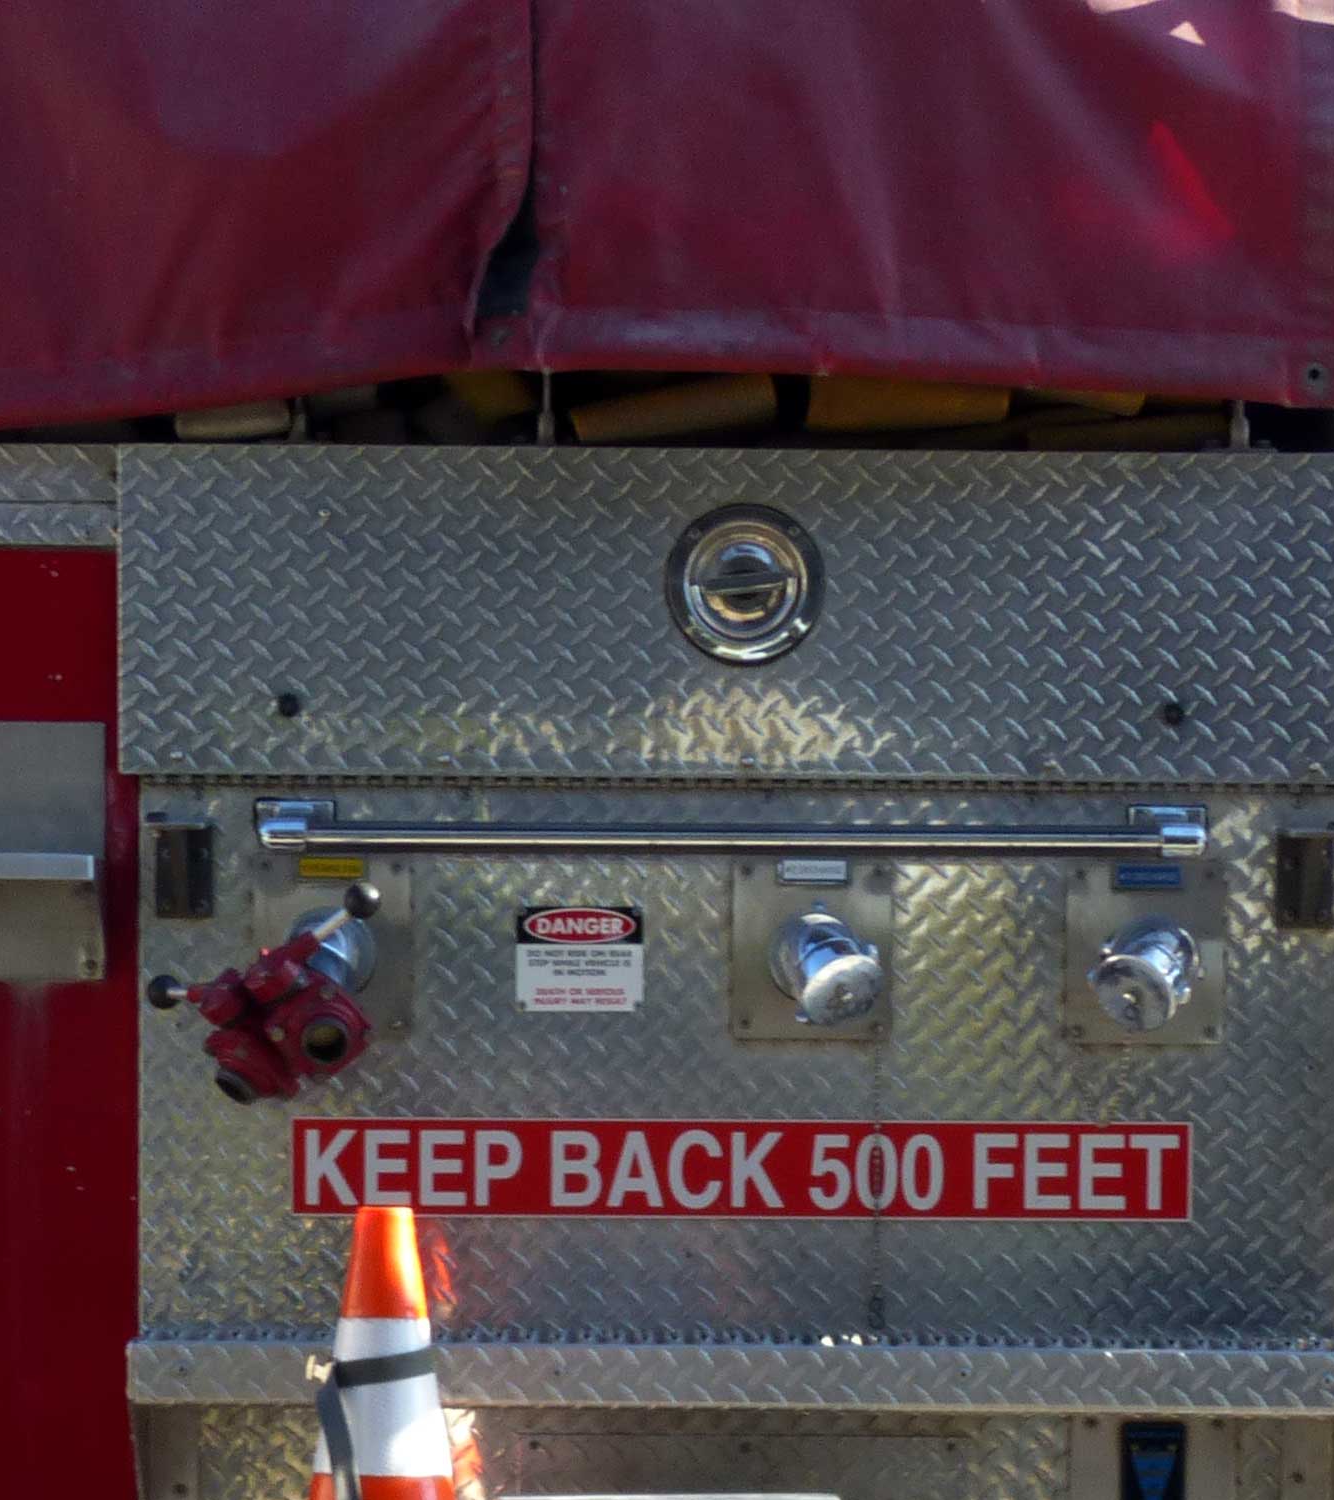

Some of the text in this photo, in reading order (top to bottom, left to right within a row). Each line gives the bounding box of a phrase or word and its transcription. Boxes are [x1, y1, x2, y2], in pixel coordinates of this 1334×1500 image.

[535, 916, 624, 935] DANGER
[303, 1128, 1181, 1211] KEEP BACK 500 FEET
